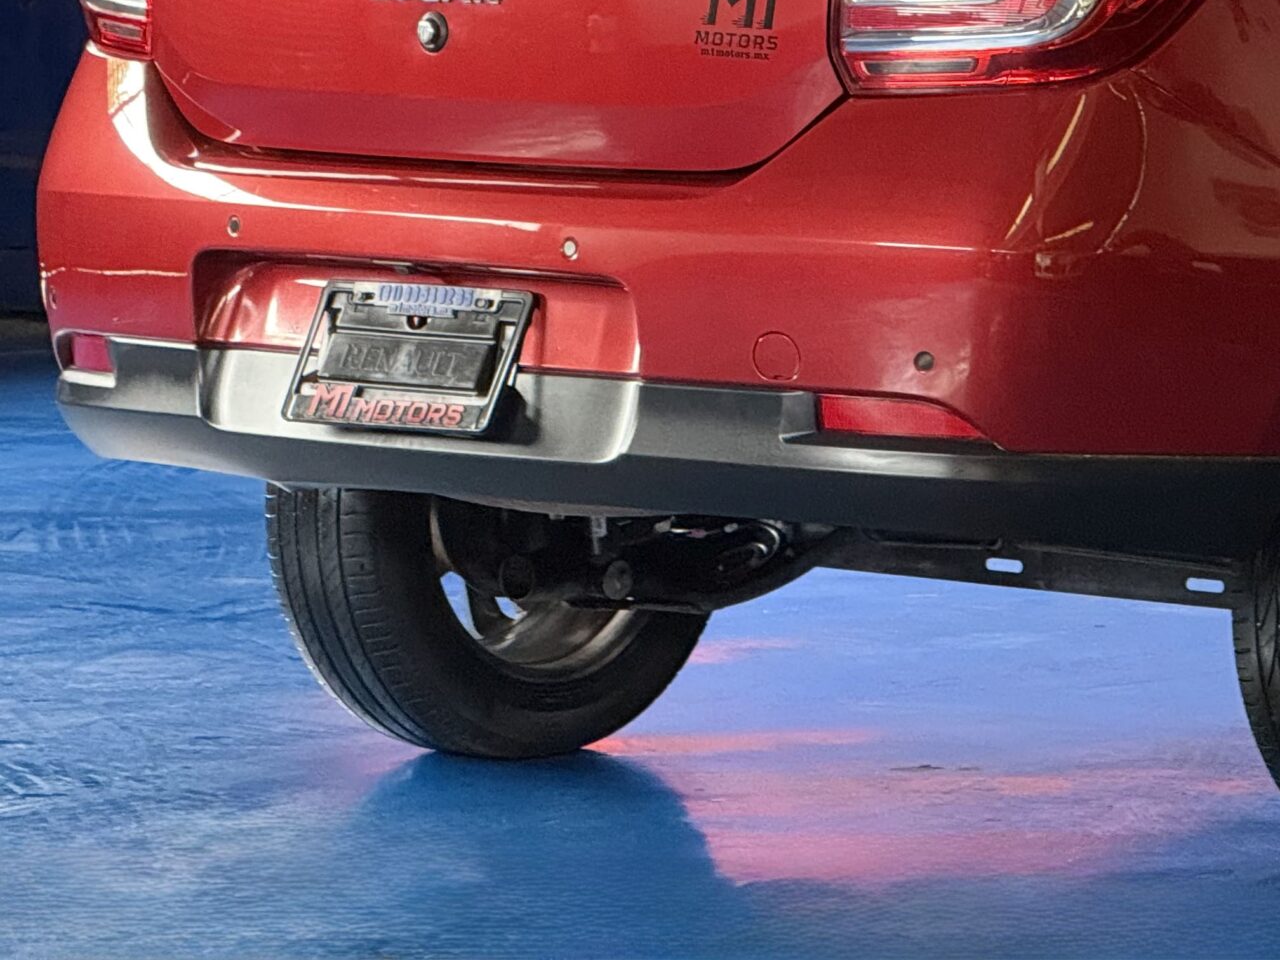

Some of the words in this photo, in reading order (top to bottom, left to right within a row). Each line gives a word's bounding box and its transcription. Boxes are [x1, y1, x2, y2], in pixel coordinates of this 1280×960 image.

[694, 30, 779, 51] MOTORS
[340, 343, 464, 378] RENAULT
[350, 397, 466, 428] MOTORS
